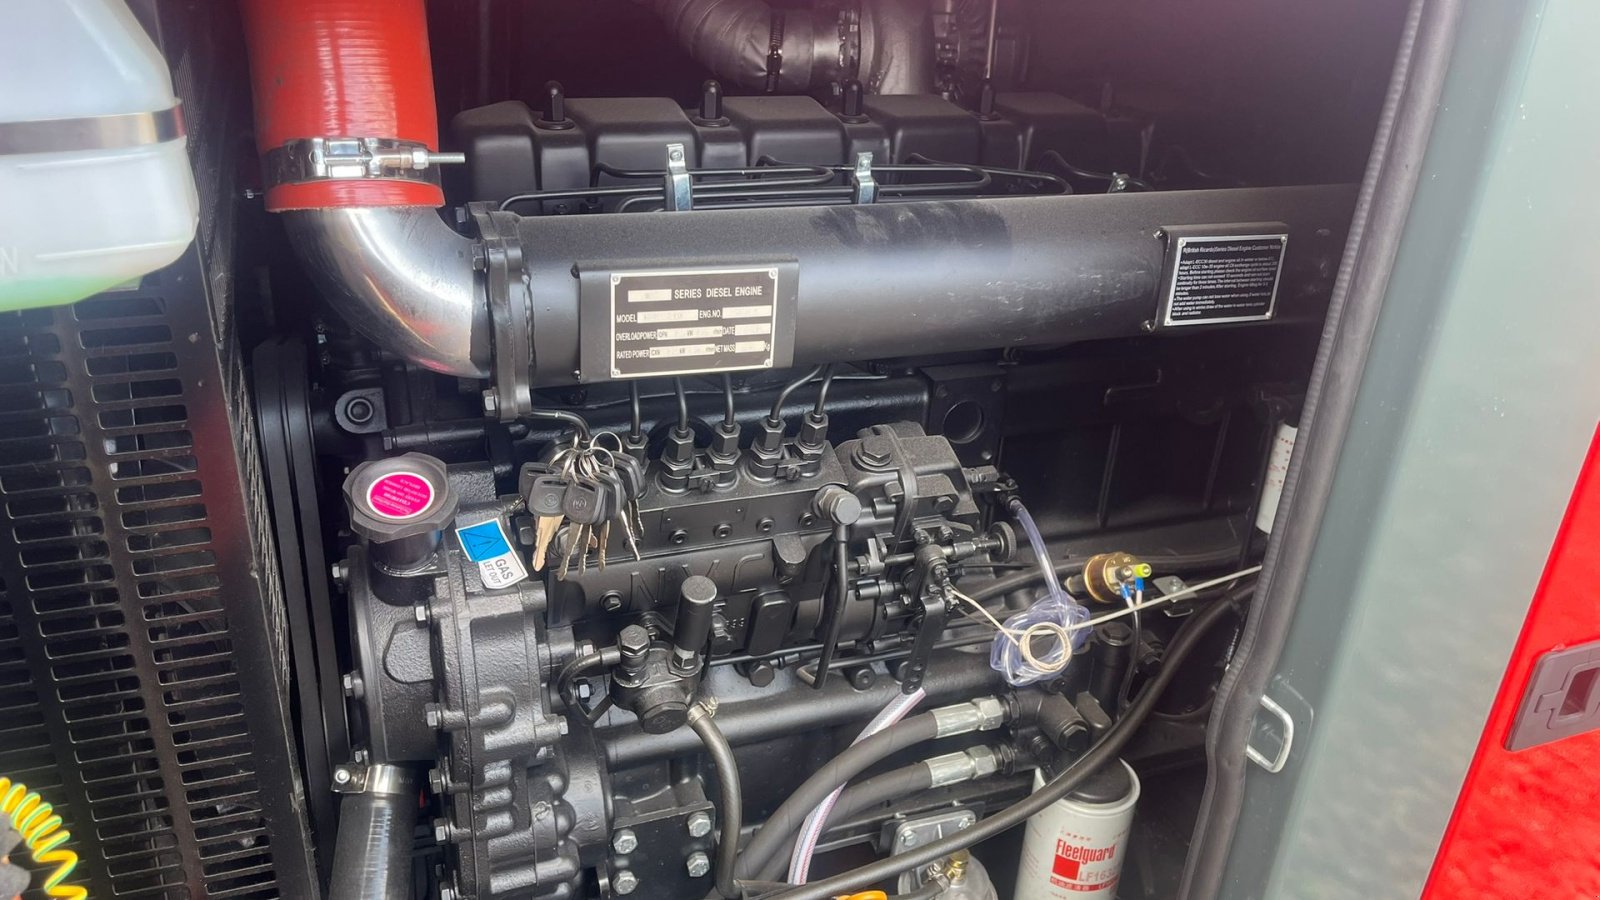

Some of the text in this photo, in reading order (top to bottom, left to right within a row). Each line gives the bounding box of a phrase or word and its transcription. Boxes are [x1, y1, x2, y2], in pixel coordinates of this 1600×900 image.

[674, 288, 702, 300] SERIES
[706, 287, 732, 298] DIESEL
[735, 286, 762, 296] ENGINE
[616, 314, 637, 323] MODEL
[722, 326, 735, 335] DATE
[616, 348, 650, 359] RATED POWER
[484, 561, 502, 584] LET OUT
[495, 558, 514, 580] GAS
[1056, 838, 1116, 865] Fleetguard
